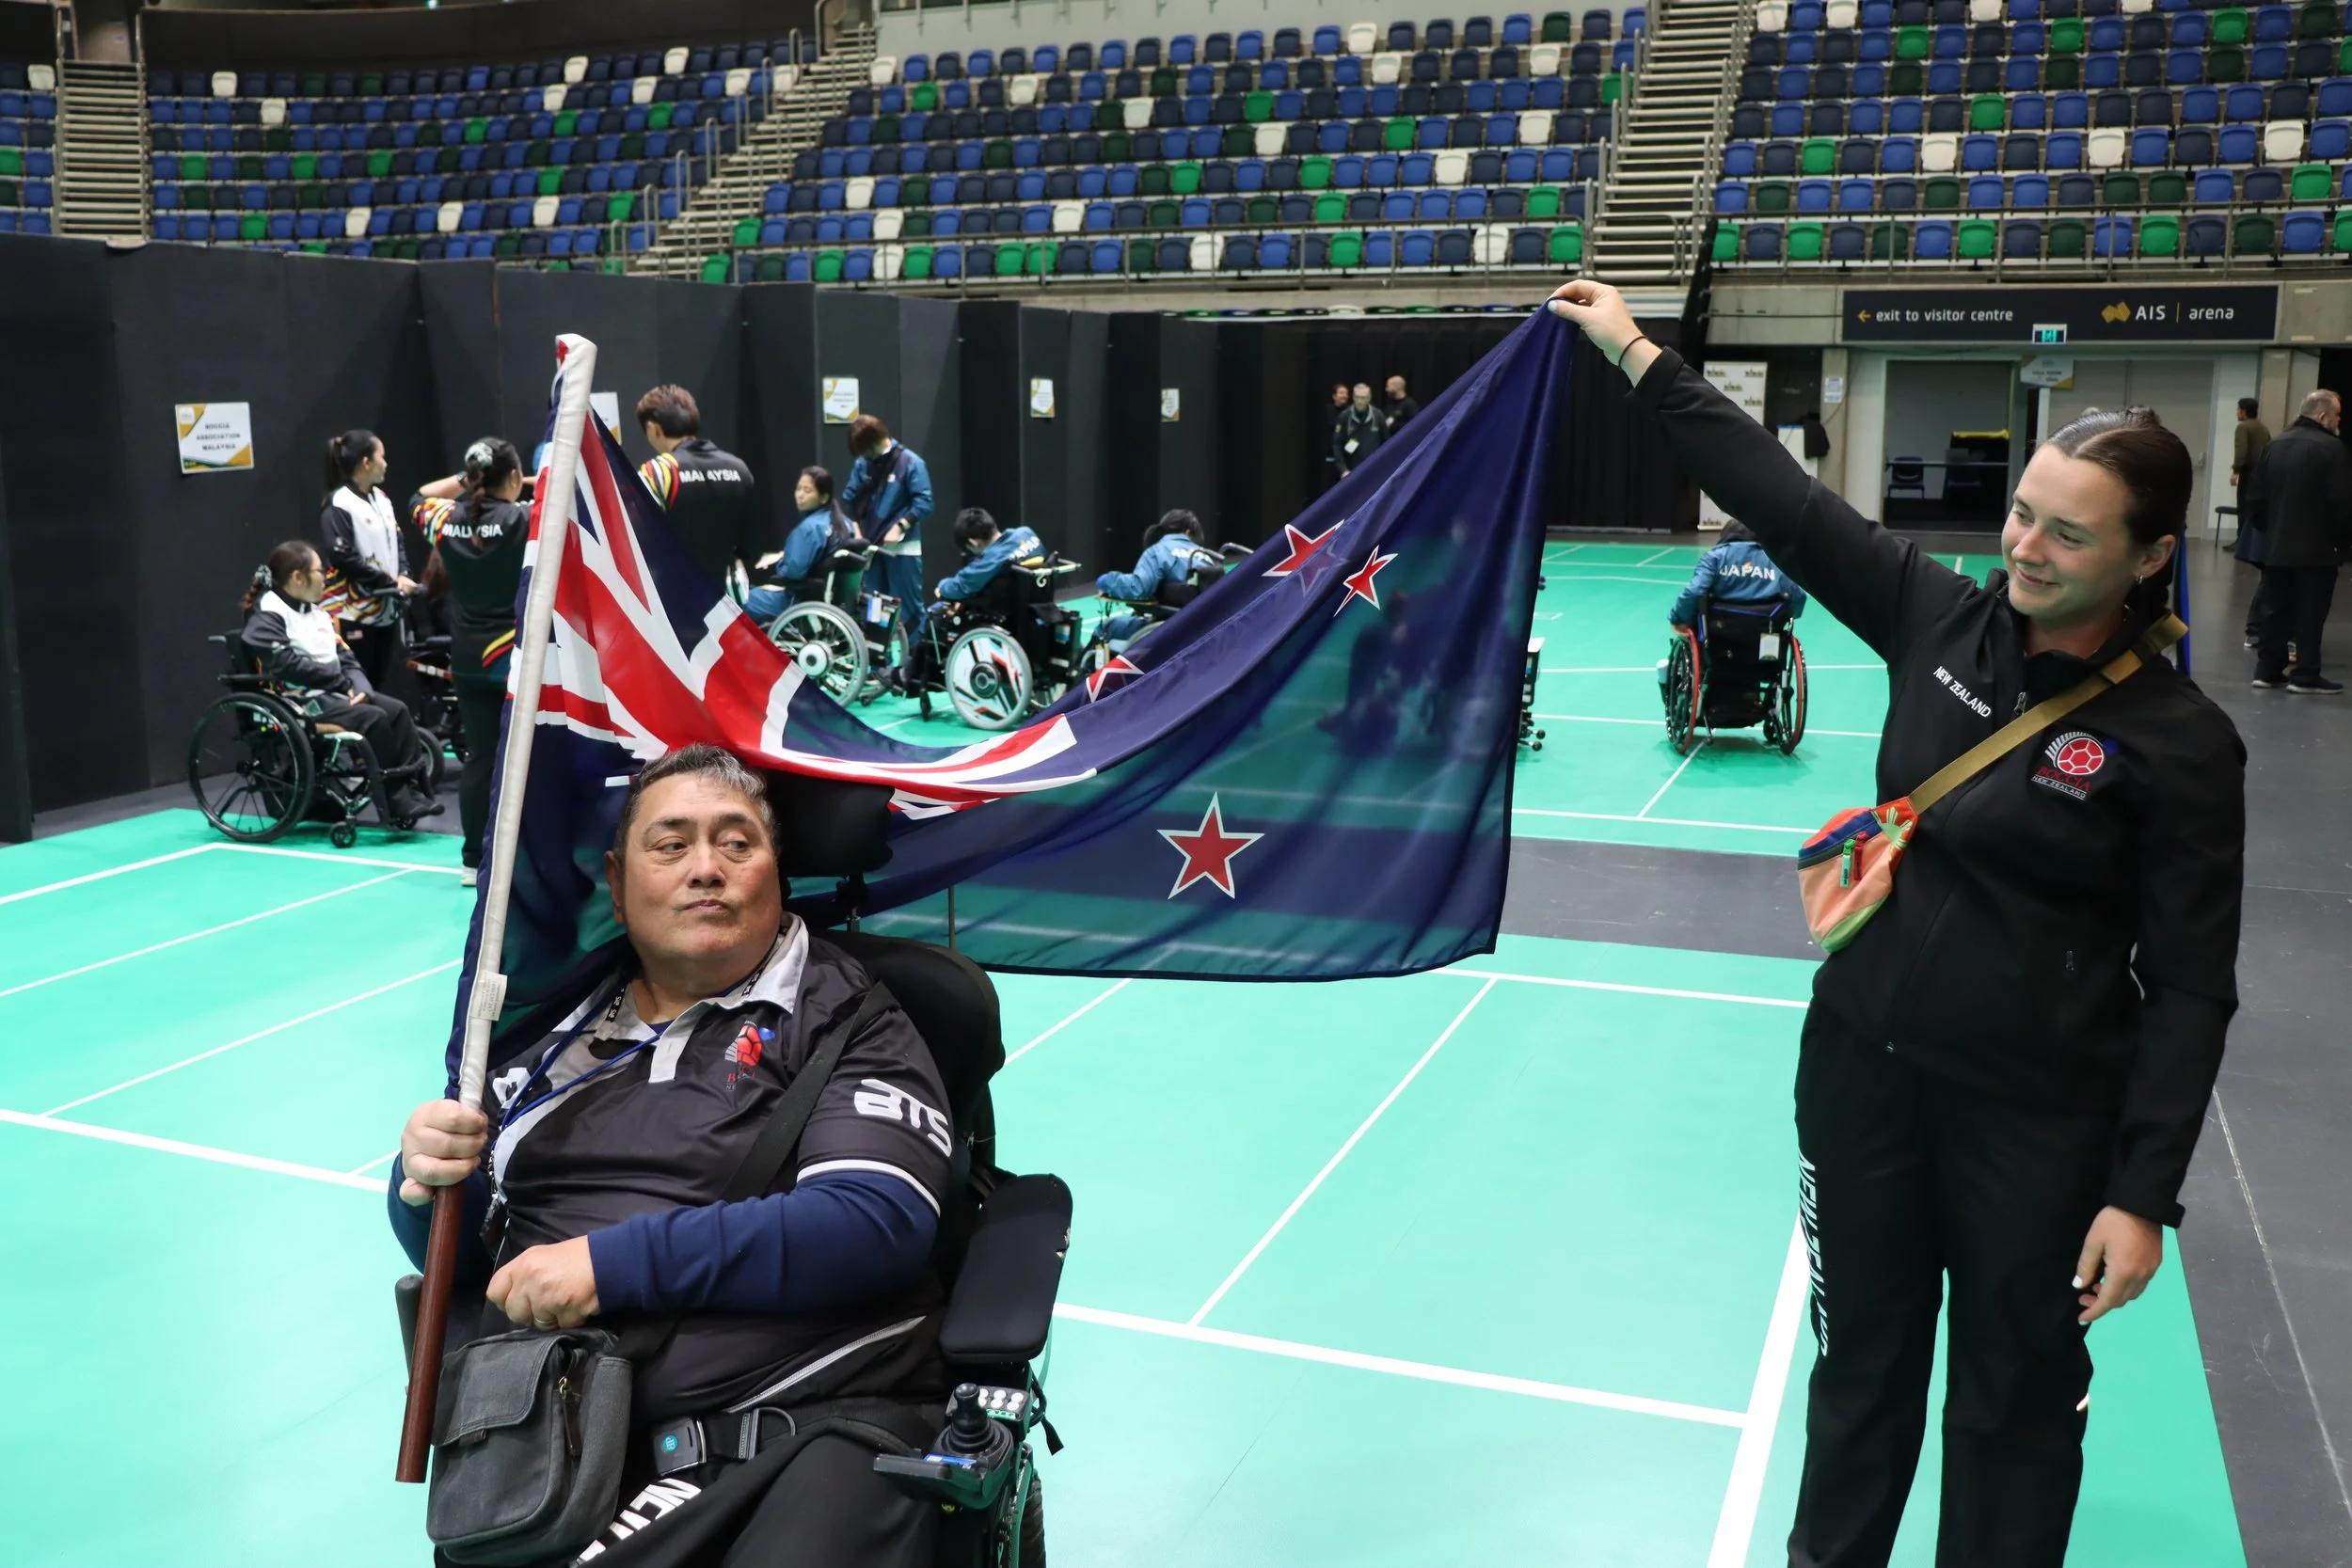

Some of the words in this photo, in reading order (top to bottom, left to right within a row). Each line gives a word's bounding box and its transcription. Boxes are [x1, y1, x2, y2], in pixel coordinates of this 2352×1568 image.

[1875, 309, 1900, 322] exit
[1905, 309, 1919, 322] to
[1924, 309, 1965, 322] visitor
[1970, 309, 2014, 322] centre
[2135, 305, 2166, 321] AIS
[2188, 308, 2234, 320] arena
[1719, 563, 1776, 581] JAPAN
[1932, 665, 1953, 686] NEW
[1948, 679, 1992, 718] ZEALAND
[2032, 775, 2048, 784] NEW
[2050, 781, 2086, 799] ZEALAND
[2036, 766, 2091, 790] BOCCIA
